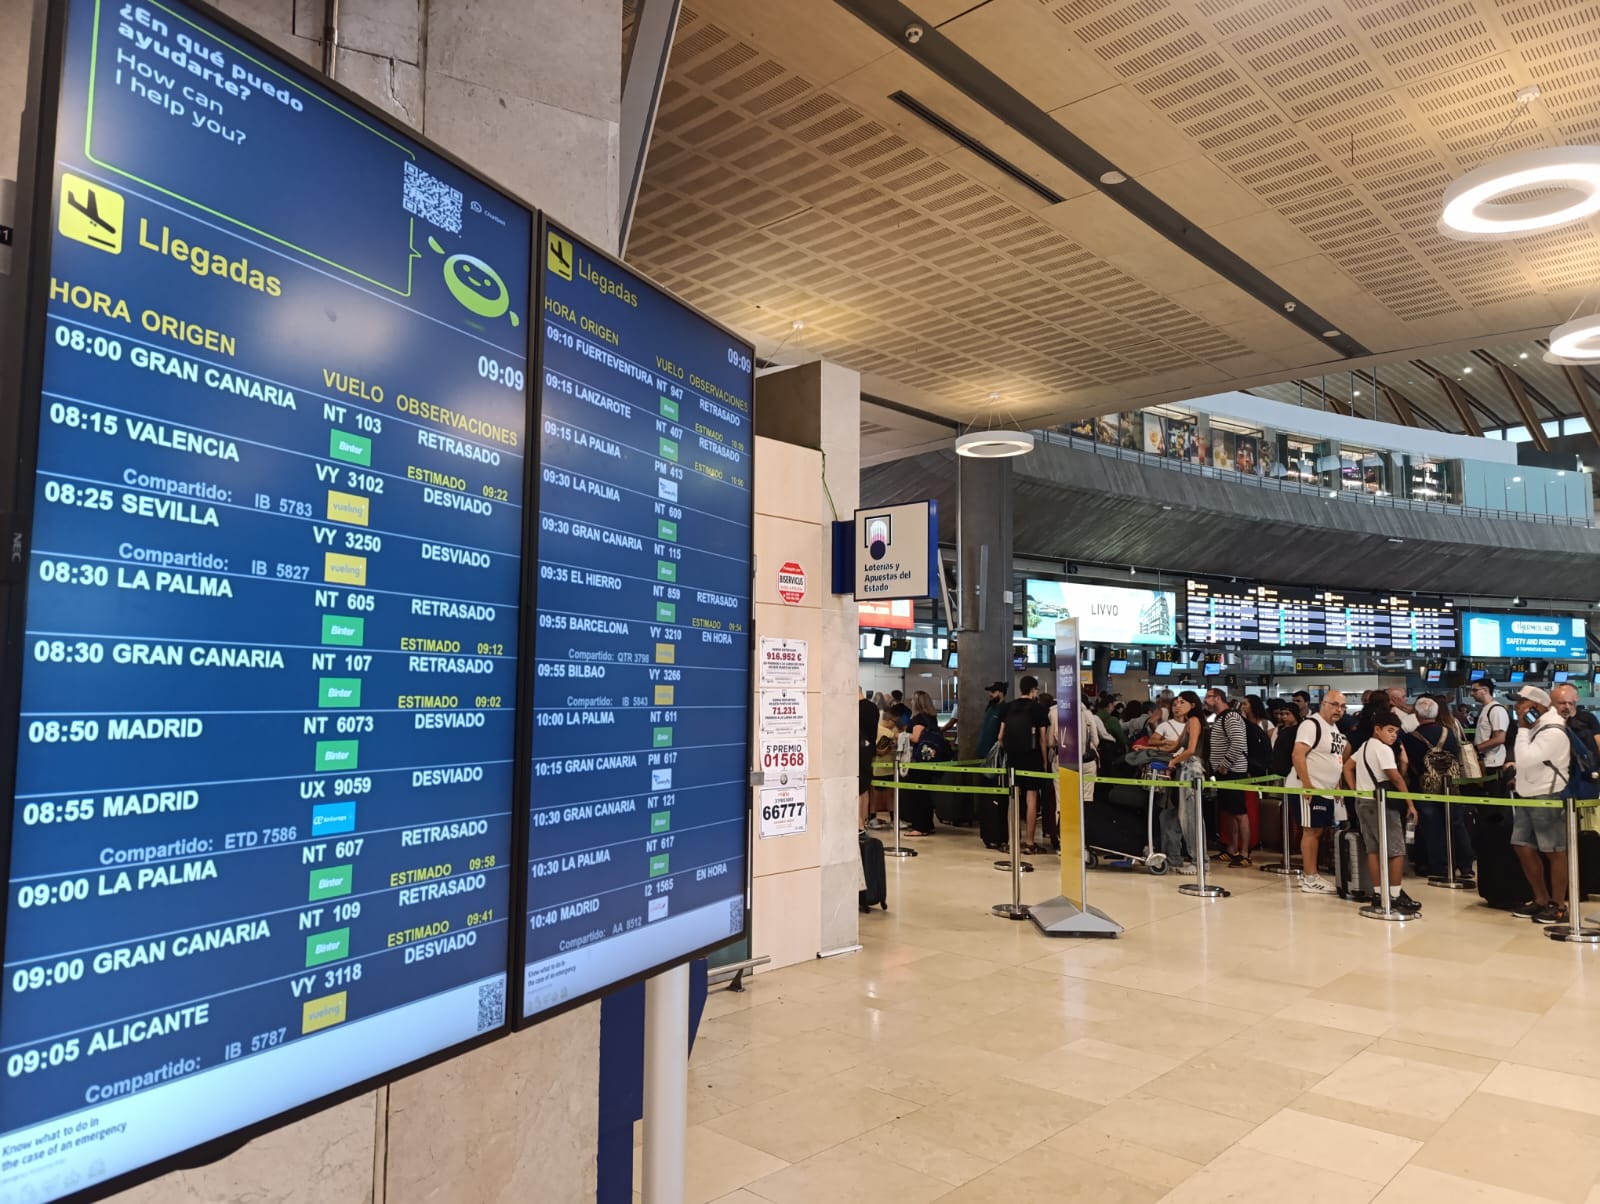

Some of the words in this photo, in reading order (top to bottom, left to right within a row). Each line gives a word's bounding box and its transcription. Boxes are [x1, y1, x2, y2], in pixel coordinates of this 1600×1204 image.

[117, 21, 251, 101] ayudarte?
[119, 3, 168, 38] ¿En
[176, 28, 224, 72] qué
[232, 62, 304, 112] puedo
[116, 47, 174, 89] How
[182, 86, 224, 115] can
[115, 69, 122, 86] I
[130, 75, 186, 116] help
[192, 109, 246, 146] you?
[138, 218, 282, 296] Llegadas
[578, 258, 638, 307] Llegadas
[50, 277, 131, 323] HORA
[142, 310, 235, 356] ORIGEN
[323, 368, 384, 402] VUELO
[396, 394, 517, 446] OBSERVACIONES
[478, 356, 524, 391] 09:09
[544, 296, 577, 325] HORA
[580, 316, 619, 346] ORIGEN
[656, 355, 684, 380] VUELO
[689, 374, 748, 412] OBSERVACIONES
[547, 326, 574, 348] 09:10
[576, 340, 654, 387] FUERTEVENTURA
[656, 378, 668, 392] NT
[670, 386, 684, 400] 947
[700, 398, 740, 426] RETRASADO
[728, 348, 751, 374] 09:09
[55, 326, 121, 361] 08:00
[131, 347, 198, 382] GRAN
[205, 369, 296, 410] CANARIA
[324, 403, 346, 424] NT
[355, 414, 382, 434] 103
[418, 430, 500, 466] RETRASADO
[546, 373, 572, 394] 09:15
[575, 384, 632, 419] LANZAROTE
[656, 419, 668, 433] NT
[670, 426, 684, 440] 407
[699, 436, 740, 462] RETRASADO
[50, 403, 118, 436] 08:15
[126, 418, 240, 462] VALENCIA
[316, 463, 339, 484] VY
[348, 472, 384, 494] 3102
[424, 488, 492, 516] DESVIADO
[123, 468, 232, 502] Compartido:
[255, 494, 270, 510] IB
[279, 498, 312, 517] 5783
[408, 466, 466, 491] ESTIMADO
[482, 485, 508, 501] 09:22
[45, 481, 114, 510] 08:25
[122, 494, 219, 527] SEVILLA
[313, 526, 337, 545] VY
[345, 532, 381, 552] 3250
[422, 544, 491, 568] DESVIADO
[119, 543, 229, 572] Compartido:
[252, 560, 267, 575] IB
[276, 564, 310, 581] 5827
[864, 573, 898, 583] Apuestas
[900, 571, 911, 579] del
[896, 563, 900, 571] y
[40, 560, 108, 586] 08:30
[118, 568, 150, 590] LA
[156, 571, 232, 598] PALMA
[315, 590, 338, 608] NT
[347, 593, 375, 611] 605
[412, 599, 496, 622] RETRASADO
[540, 566, 568, 582] 09:35
[570, 570, 584, 584] EL
[586, 572, 622, 590] HIERRO
[653, 584, 664, 597] NT
[696, 592, 738, 608] RETRASADO
[864, 584, 888, 592] Estado
[540, 614, 567, 629] 09:55
[570, 617, 629, 635] BARCELONA
[650, 626, 662, 638] VY
[664, 628, 682, 640] 3210
[702, 631, 712, 642] EN
[713, 632, 733, 644] HORA
[1091, 604, 1118, 616] LIVVO
[34, 640, 104, 663] 08:30
[112, 644, 183, 666] GRAN
[189, 647, 284, 668] CANARIA
[312, 653, 336, 670] NT
[345, 655, 372, 671] 107
[409, 656, 494, 674] RETRASADO
[538, 664, 566, 678] 09:55
[568, 664, 606, 678] BILBAO
[649, 668, 660, 680] VY
[28, 720, 99, 743] 08:50
[107, 718, 203, 740] MADRID
[304, 717, 328, 734] NT
[336, 716, 374, 733] 6073
[414, 713, 485, 729] DESVIADO
[536, 712, 564, 726] 10:00
[566, 712, 580, 724] LA
[582, 711, 615, 724] PALMA
[650, 711, 662, 722] NT
[664, 711, 678, 722] 611
[764, 752, 804, 768] 01568
[773, 744, 802, 752] PREMIO
[23, 798, 94, 826] 08:55
[103, 790, 199, 818] MADRID
[300, 780, 325, 798] UX
[334, 777, 372, 796] 9059
[412, 767, 483, 787] DESVIADO
[762, 802, 804, 820] 66777
[100, 838, 214, 864] Compartido:
[224, 831, 258, 850] ETD
[262, 826, 297, 846] 7586
[530, 910, 558, 930] 10:40
[560, 898, 600, 920] MADRID
[696, 869, 706, 881] EN
[708, 863, 728, 877] HORA
[559, 929, 606, 951] Compartido:
[7, 1038, 80, 1078] 09:05
[87, 1003, 210, 1056] ALICANTE
[291, 975, 316, 998] VY
[325, 963, 362, 989] 3118
[404, 930, 476, 964] DESVIADO
[85, 1057, 200, 1103] Compartido:
[225, 1042, 242, 1060] IB
[251, 1028, 287, 1052] 5787
[2, 1141, 32, 1156] Know
[35, 1130, 60, 1146] what
[64, 1126, 73, 1136] to
[76, 1121, 88, 1132] do
[90, 1118, 99, 1127] in
[2, 1159, 18, 1171] the
[22, 1150, 45, 1164] case
[48, 1144, 58, 1156] of
[60, 1141, 72, 1151] an
[75, 1122, 127, 1146] emergency
